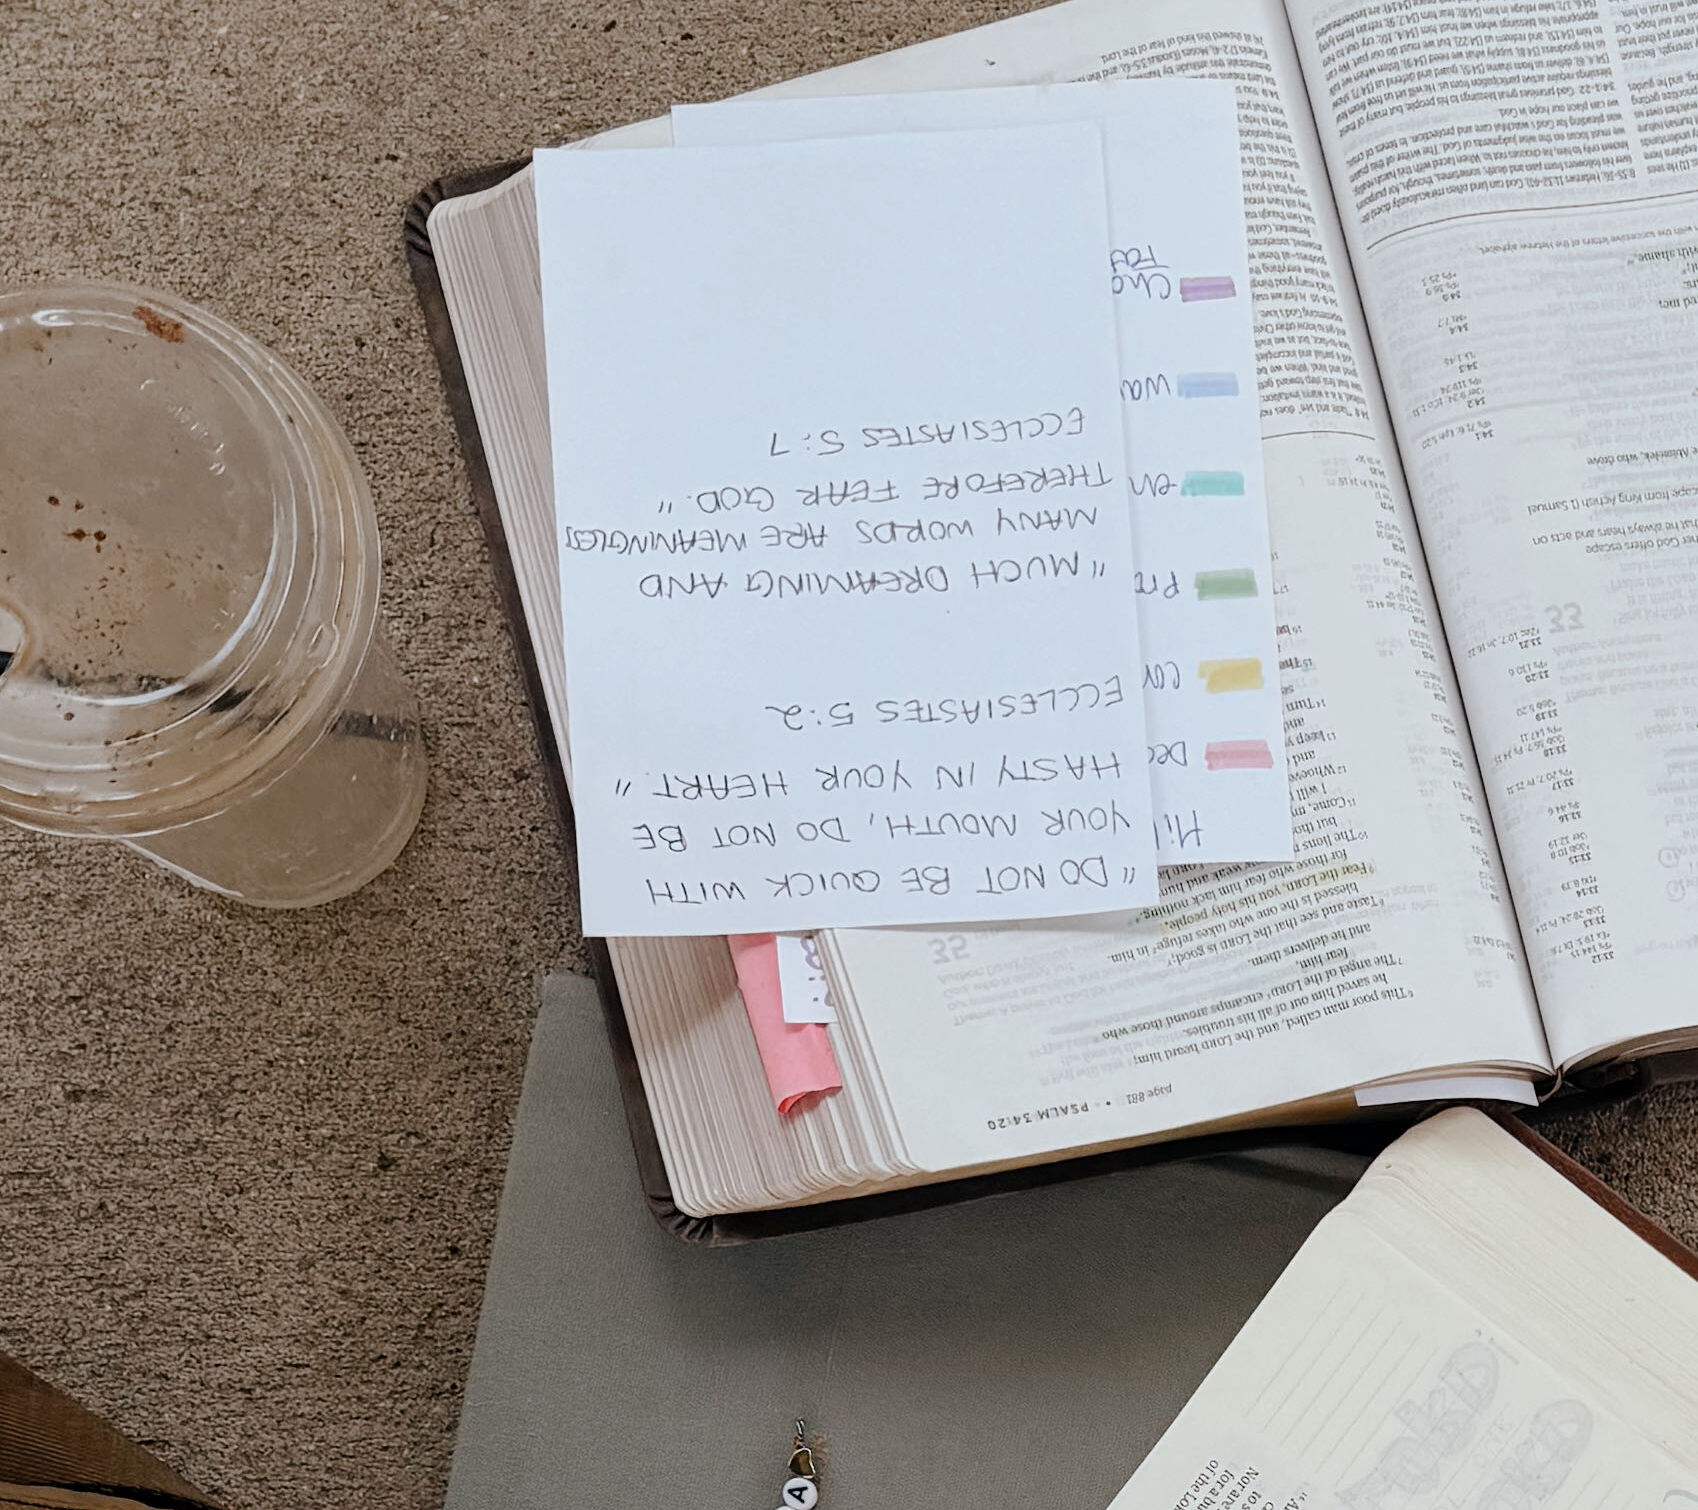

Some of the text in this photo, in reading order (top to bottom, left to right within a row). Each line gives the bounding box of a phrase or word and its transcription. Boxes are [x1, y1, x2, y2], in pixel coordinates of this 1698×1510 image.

[769, 405, 1085, 457] ECCLESIASTES 5:7
[795, 478, 900, 507] FEAR
[921, 460, 1113, 500] THEREFORE
[564, 505, 1097, 556] MANY WORDS ARE MEANINGLESS
[638, 550, 1105, 599] "MUCH DREAMING AND
[763, 673, 1124, 731] ECCLESIASTES 5:2
[814, 758, 912, 792] YOUR
[935, 761, 975, 790] IN
[997, 750, 1121, 787] HASTY
[632, 798, 1131, 853] YOUR MOUTH, DO NOT BE
[645, 853, 1136, 905] "DO NOT BE QUICK WITH
[1145, 1081, 1172, 1098] page
[986, 1112, 1032, 1131] 34:20
[1036, 1101, 1089, 1120] PSALM
